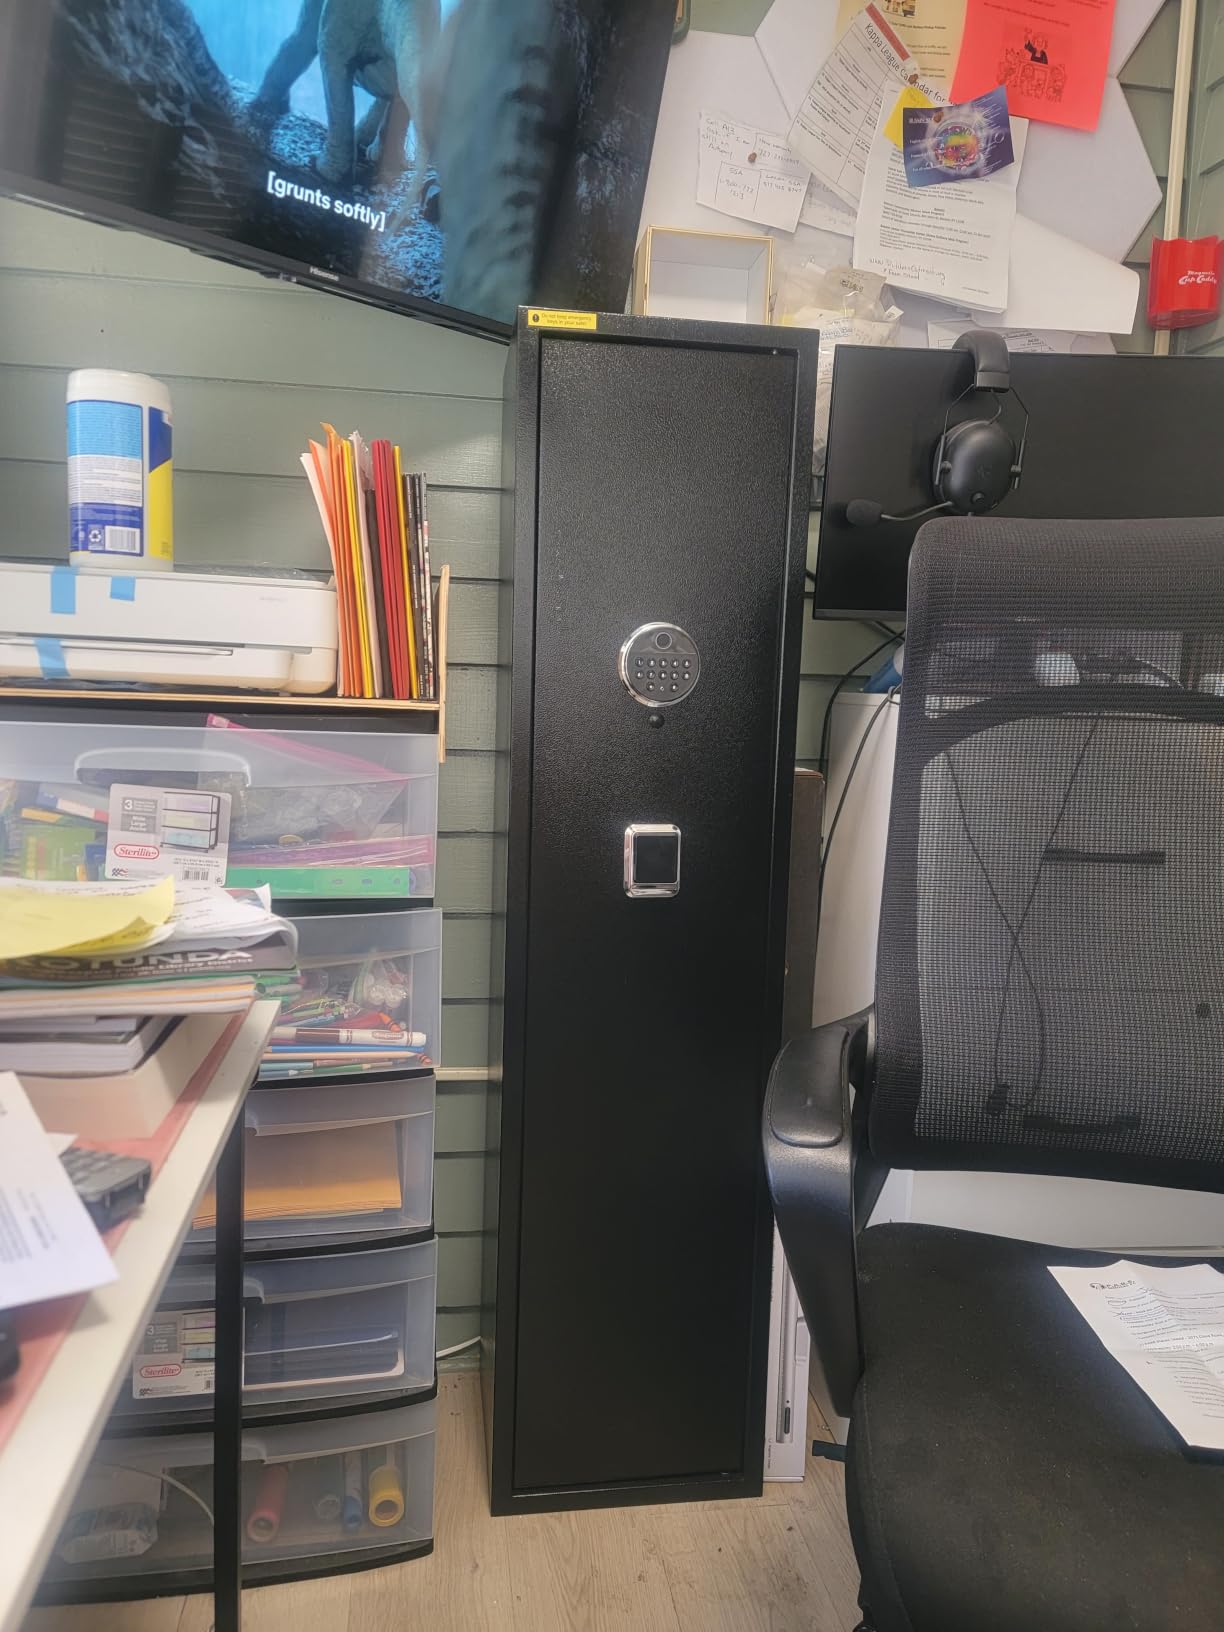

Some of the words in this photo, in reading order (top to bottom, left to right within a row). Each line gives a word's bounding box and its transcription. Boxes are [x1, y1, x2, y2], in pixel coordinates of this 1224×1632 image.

[865, 23, 883, 48] Kappa
[881, 44, 900, 72] League
[900, 69, 933, 97] Candar
[934, 91, 946, 104] for
[267, 170, 331, 210] [grunts
[334, 199, 386, 232] softly]
[123, 799, 133, 810] 3
